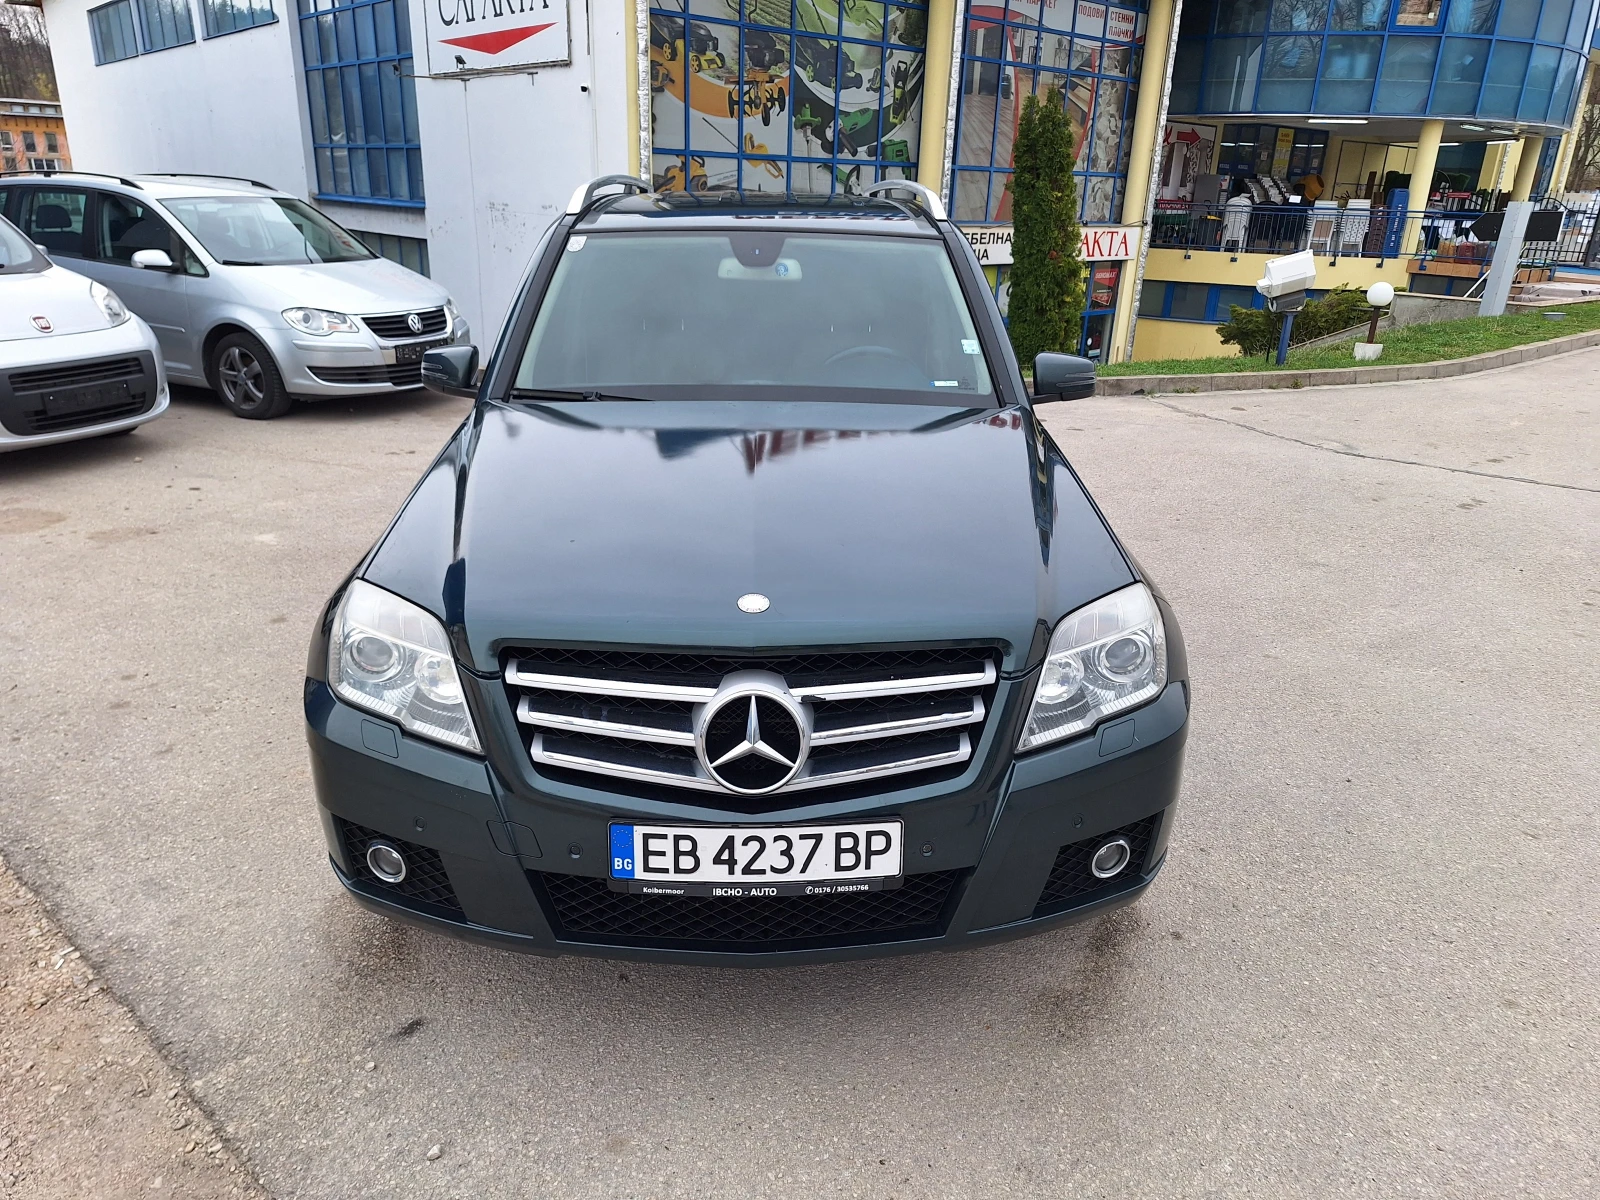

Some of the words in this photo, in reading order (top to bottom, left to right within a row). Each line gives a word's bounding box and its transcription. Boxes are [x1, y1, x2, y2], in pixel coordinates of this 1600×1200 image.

[1078, 5, 1105, 19] ПОДОВИ
[1110, 11, 1134, 25] СТЕННИ
[1108, 26, 1134, 39] ПЛОЧКИ
[712, 833, 823, 876] 4237
[834, 829, 892, 872] BP
[614, 858, 632, 870] BG
[713, 888, 742, 896] IBCHO
[750, 888, 777, 896] AUTO
